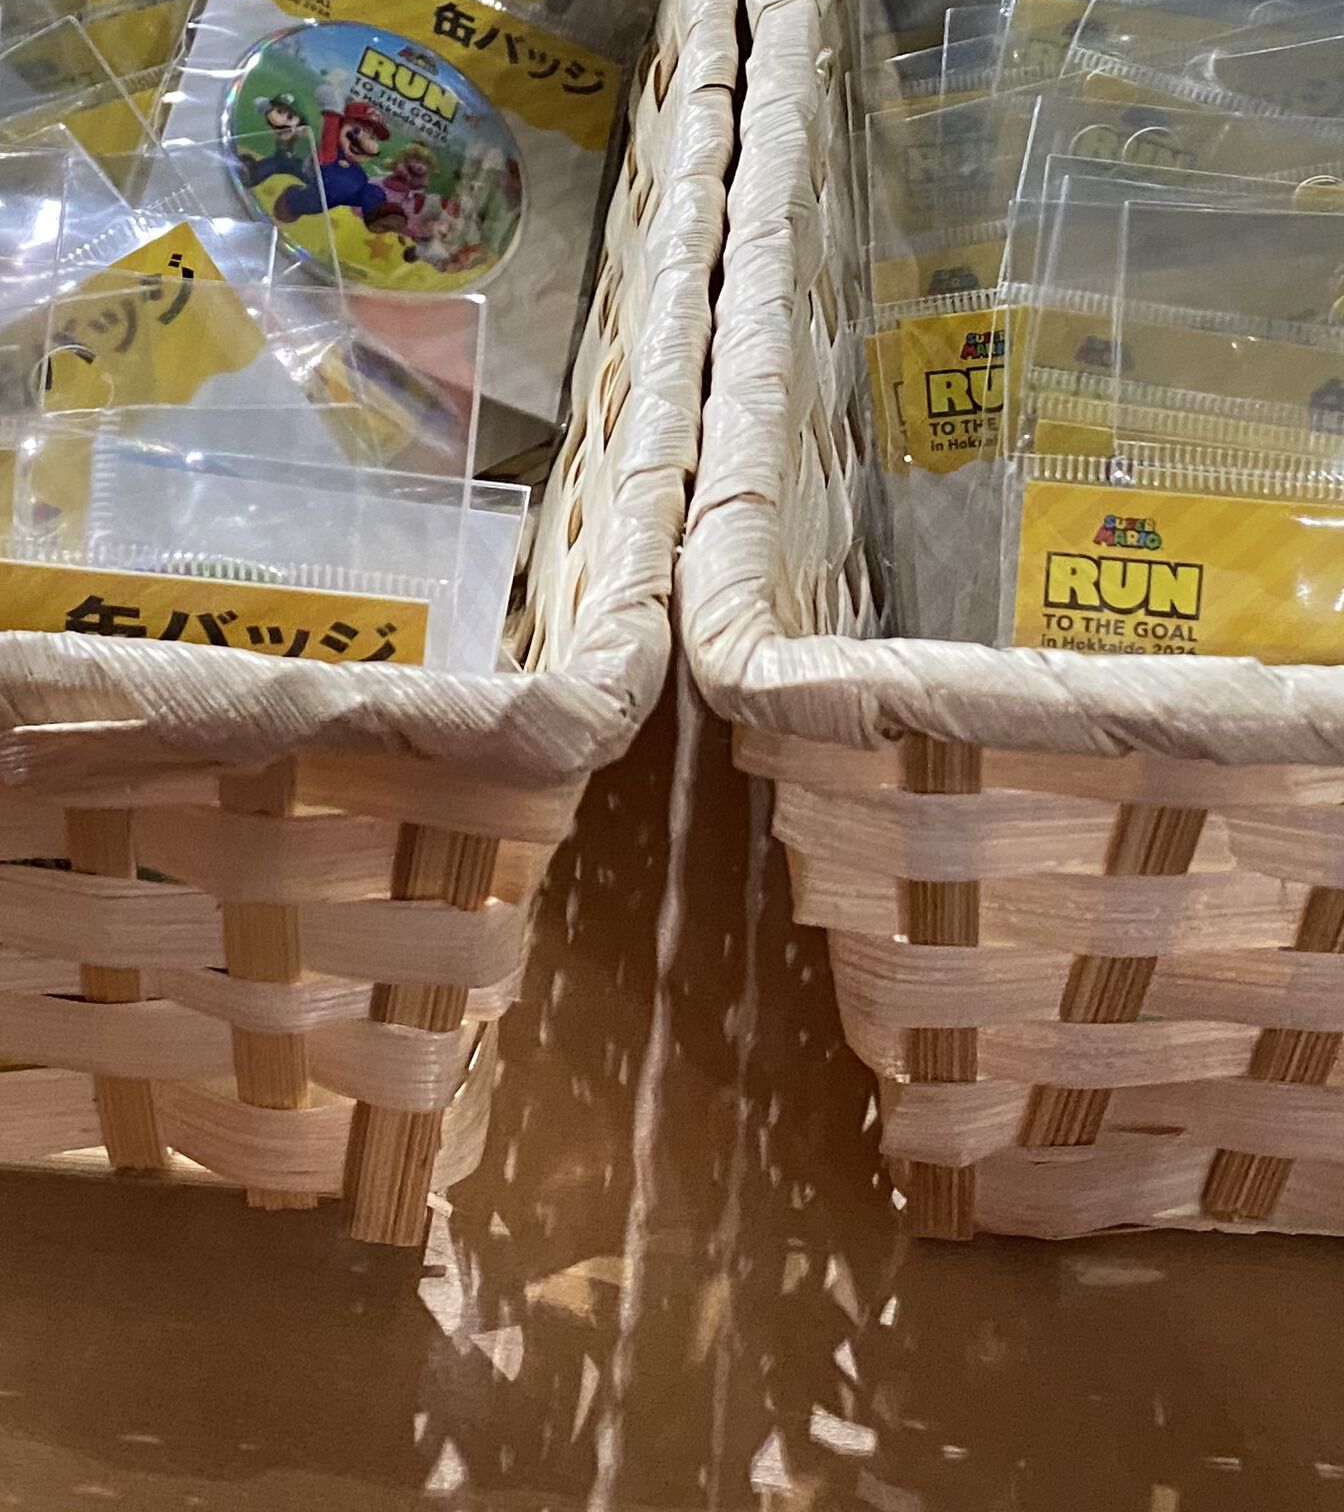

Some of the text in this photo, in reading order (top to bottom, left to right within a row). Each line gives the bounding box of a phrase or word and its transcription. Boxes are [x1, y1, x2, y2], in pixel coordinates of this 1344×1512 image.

[433, 2, 604, 94] 缶バッジ
[357, 45, 460, 123] RUN
[354, 77, 449, 136] TO THE GOAL
[929, 421, 956, 437] TO
[931, 439, 944, 451] in
[1103, 514, 1157, 533] SUPER
[1092, 526, 1163, 551] MARIO
[1043, 551, 1204, 621] RUN
[1043, 613, 1198, 642] TO THE GOAL
[1041, 634, 1056, 648] in
[1061, 635, 1147, 655] Hokkaido
